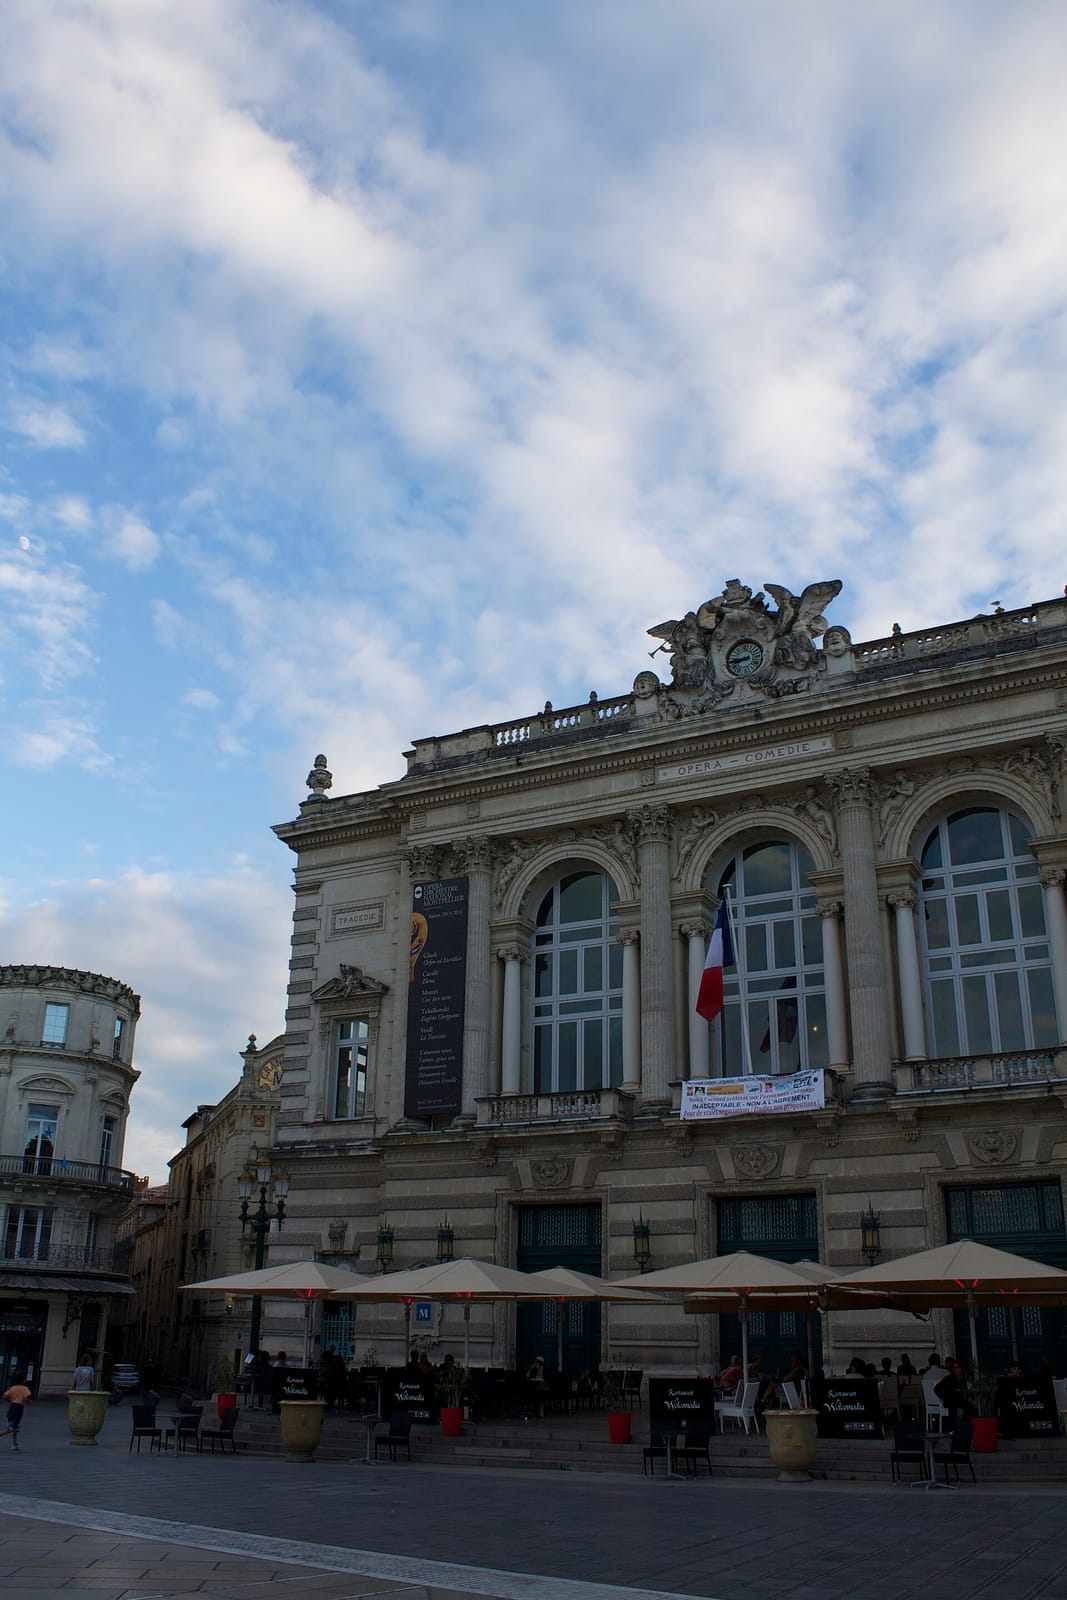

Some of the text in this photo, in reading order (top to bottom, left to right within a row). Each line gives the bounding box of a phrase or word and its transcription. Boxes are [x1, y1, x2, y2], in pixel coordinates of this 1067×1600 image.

[677, 760, 722, 776] OPERA
[745, 743, 811, 763] COMEDIE
[424, 895, 465, 905] MONTPELLIER
[339, 913, 376, 925] TRAGEDIE
[768, 1094, 811, 1104] L'AGREMENT
[784, 1101, 817, 1111] propositions
[419, 1308, 429, 1319] M
